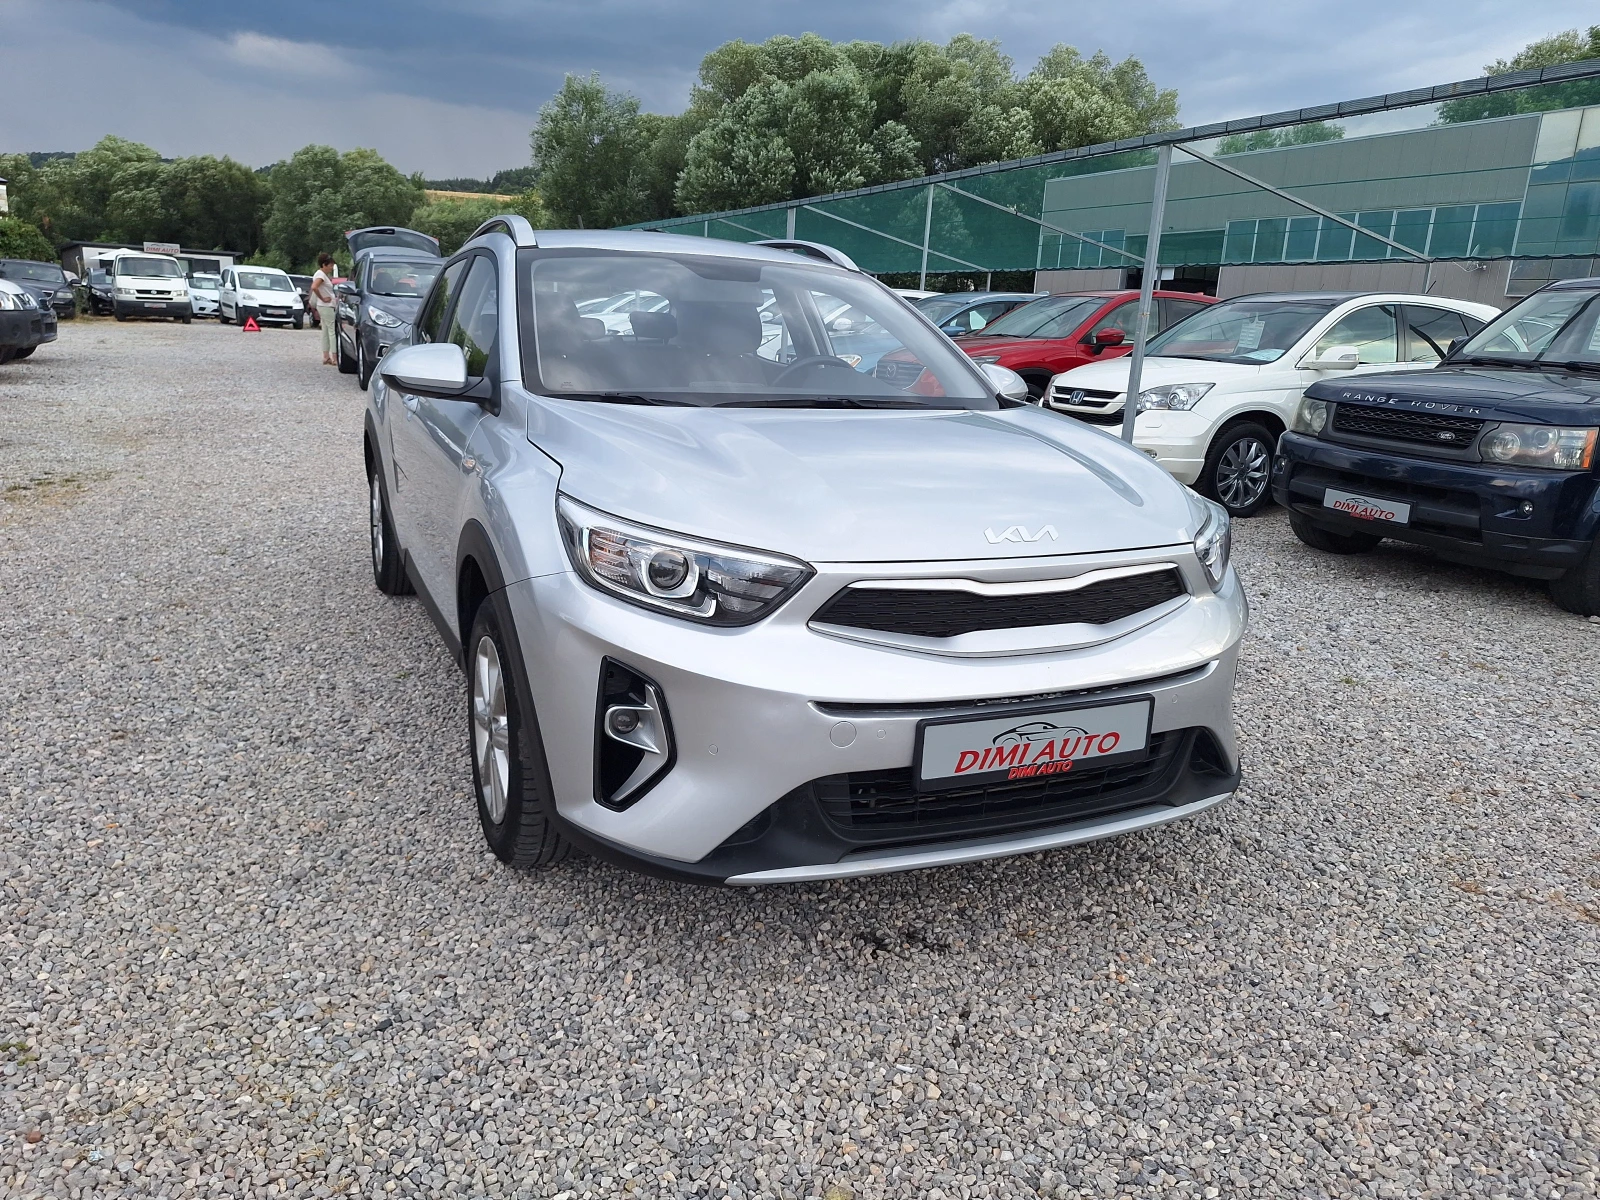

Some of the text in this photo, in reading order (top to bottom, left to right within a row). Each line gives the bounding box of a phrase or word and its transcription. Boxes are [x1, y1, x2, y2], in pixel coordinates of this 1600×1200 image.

[1342, 392, 1481, 414] RANGE ROVER
[1333, 500, 1359, 512] DIMI
[1359, 507, 1395, 520] AUTO
[983, 524, 1059, 544] KIA
[954, 731, 1120, 773] DIMI AUTO
[1008, 760, 1073, 780] DIMI AUTO
